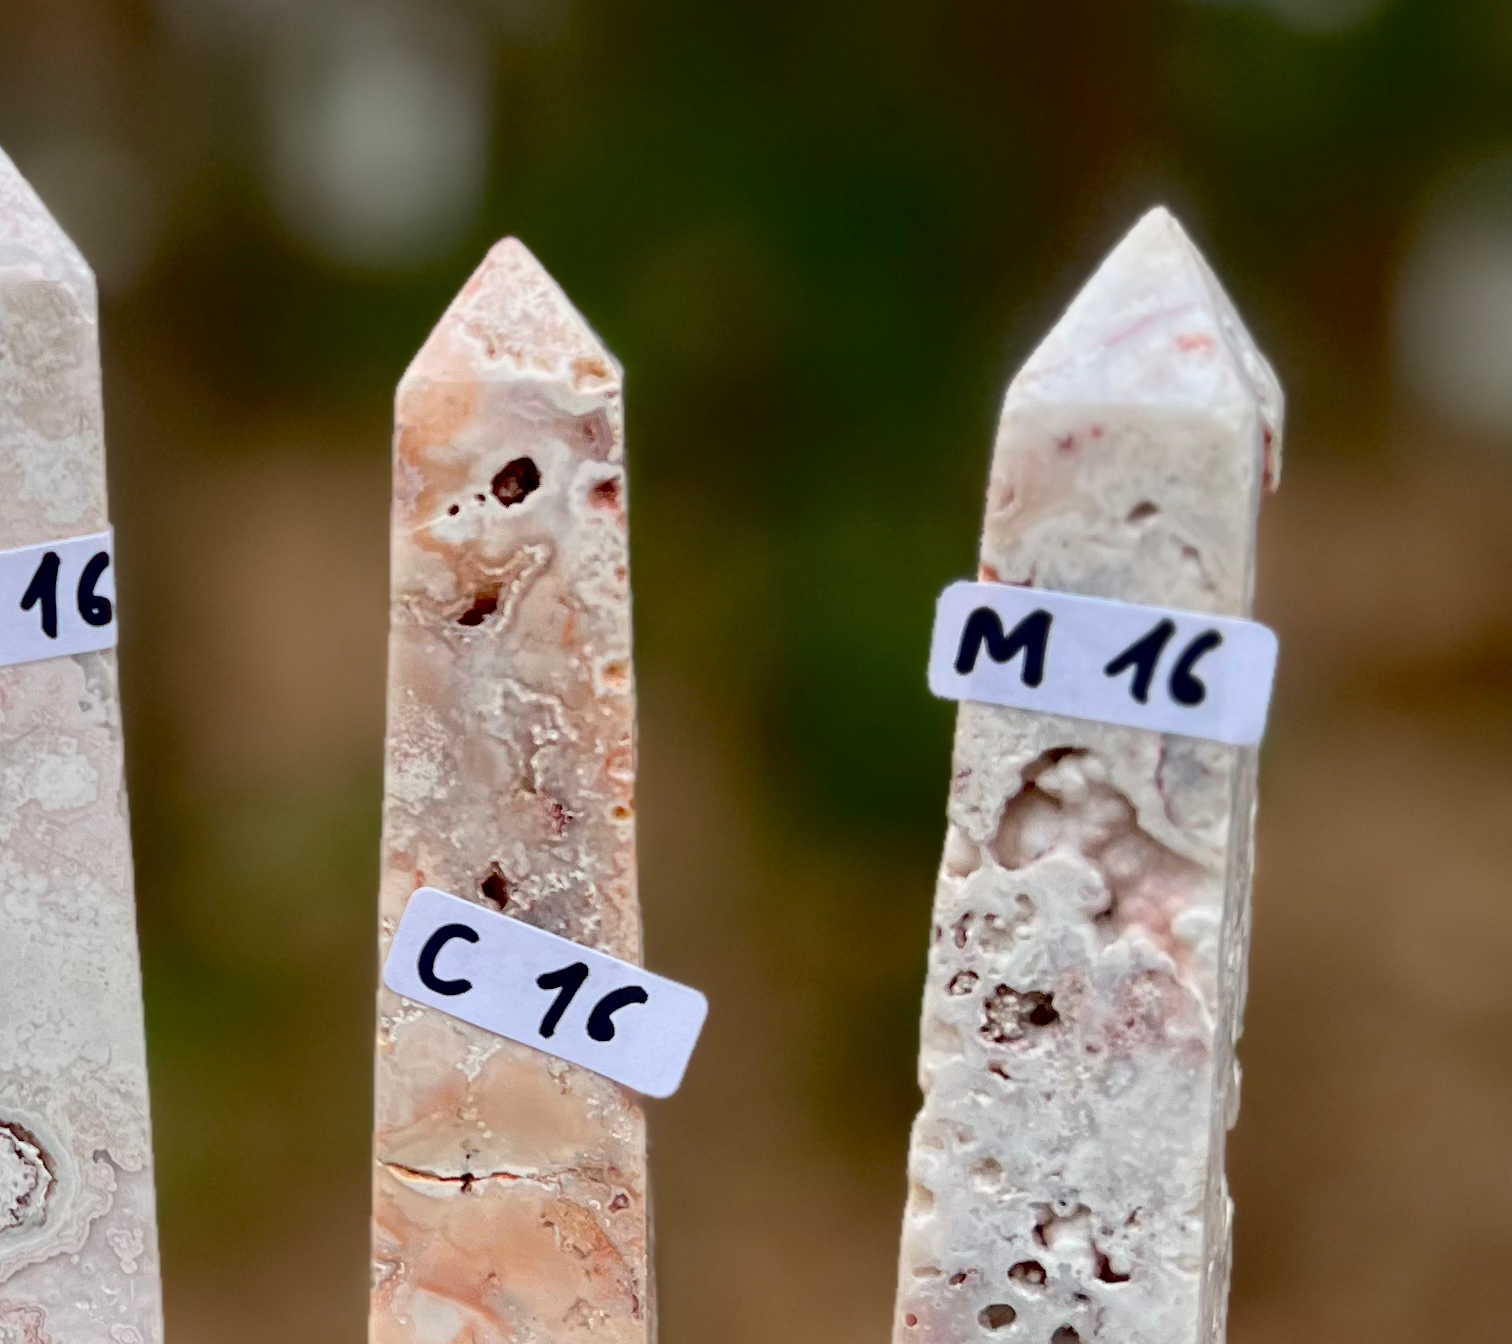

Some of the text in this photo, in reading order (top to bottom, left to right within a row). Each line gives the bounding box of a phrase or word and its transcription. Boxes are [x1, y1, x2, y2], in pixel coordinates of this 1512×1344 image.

[20, 551, 113, 639] 16
[954, 606, 1223, 707] M 16
[417, 923, 649, 1042] C 16
